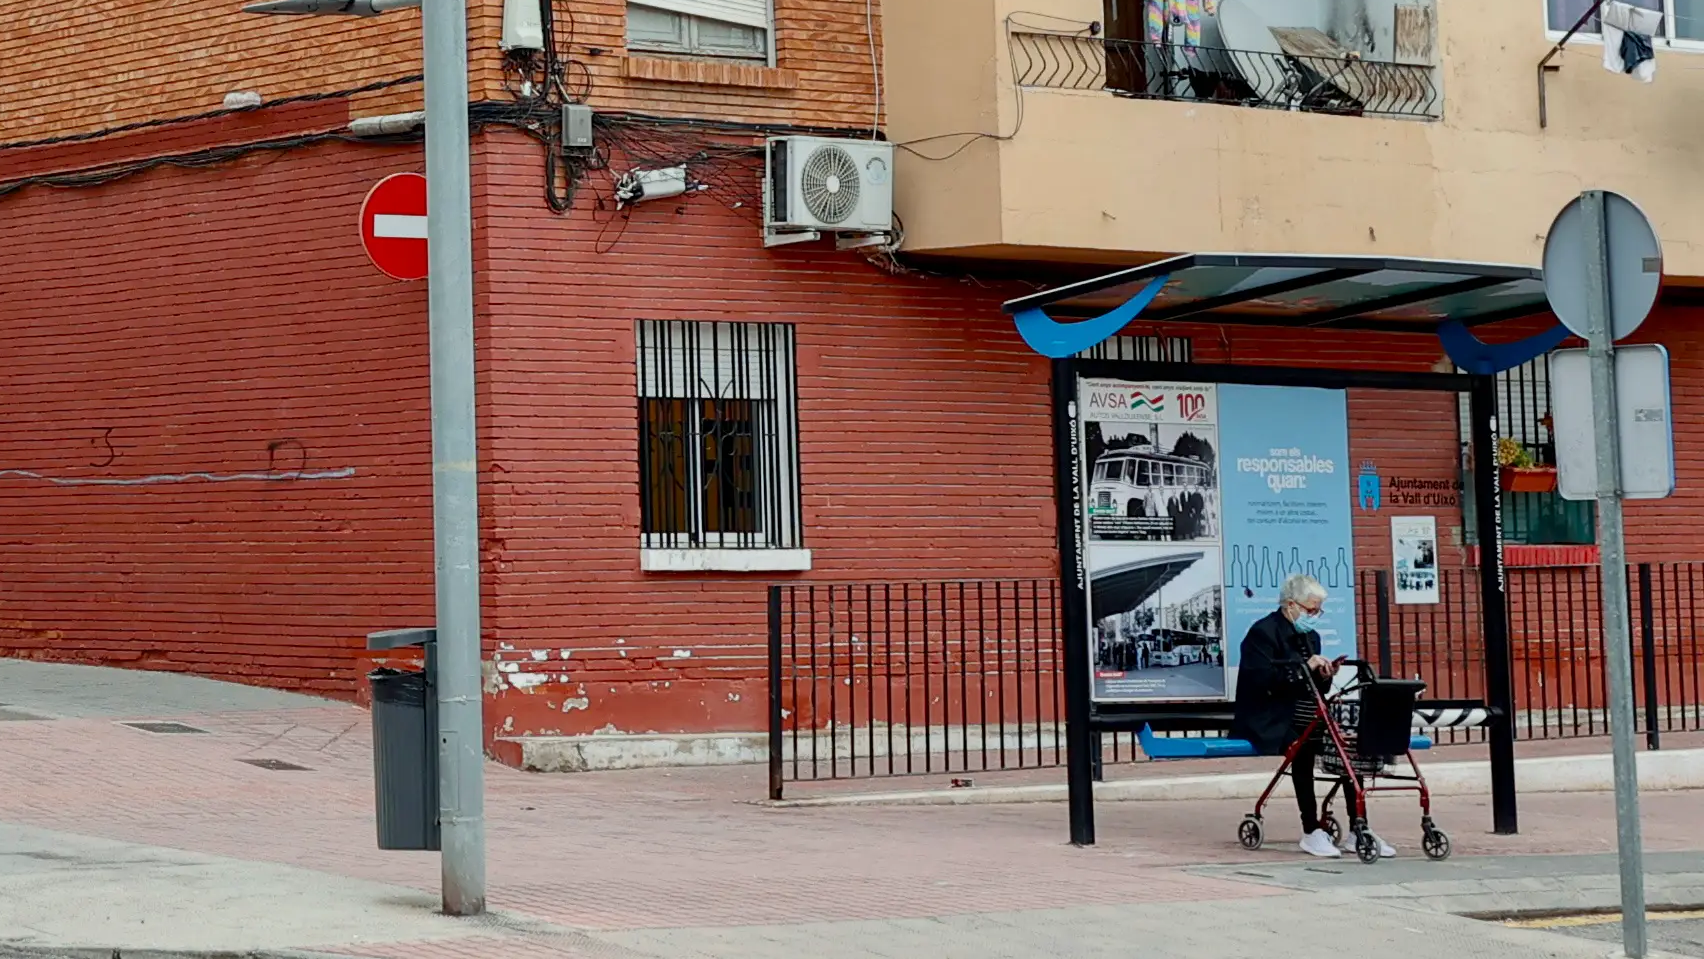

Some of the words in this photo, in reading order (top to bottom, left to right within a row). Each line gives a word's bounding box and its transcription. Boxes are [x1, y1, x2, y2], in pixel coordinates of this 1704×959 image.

[1089, 392, 1128, 409] AVSA
[1176, 392, 1205, 421] 100
[1270, 448, 1288, 457] som
[1289, 447, 1301, 457] els
[1070, 457, 1079, 486] VALL
[1237, 455, 1334, 478] responsables
[1267, 473, 1307, 494] quan:
[1389, 477, 1450, 492] Ajuntament
[1492, 467, 1500, 495] VALL
[1072, 486, 1080, 503] LA
[1390, 491, 1399, 504] la
[1401, 492, 1422, 505] Vall
[1493, 495, 1501, 509] LA
[1072, 503, 1081, 517] DE
[1494, 509, 1502, 524] DE
[1074, 519, 1085, 591] AJUNTAMENT
[1495, 525, 1505, 593] AJUNTAMENT
